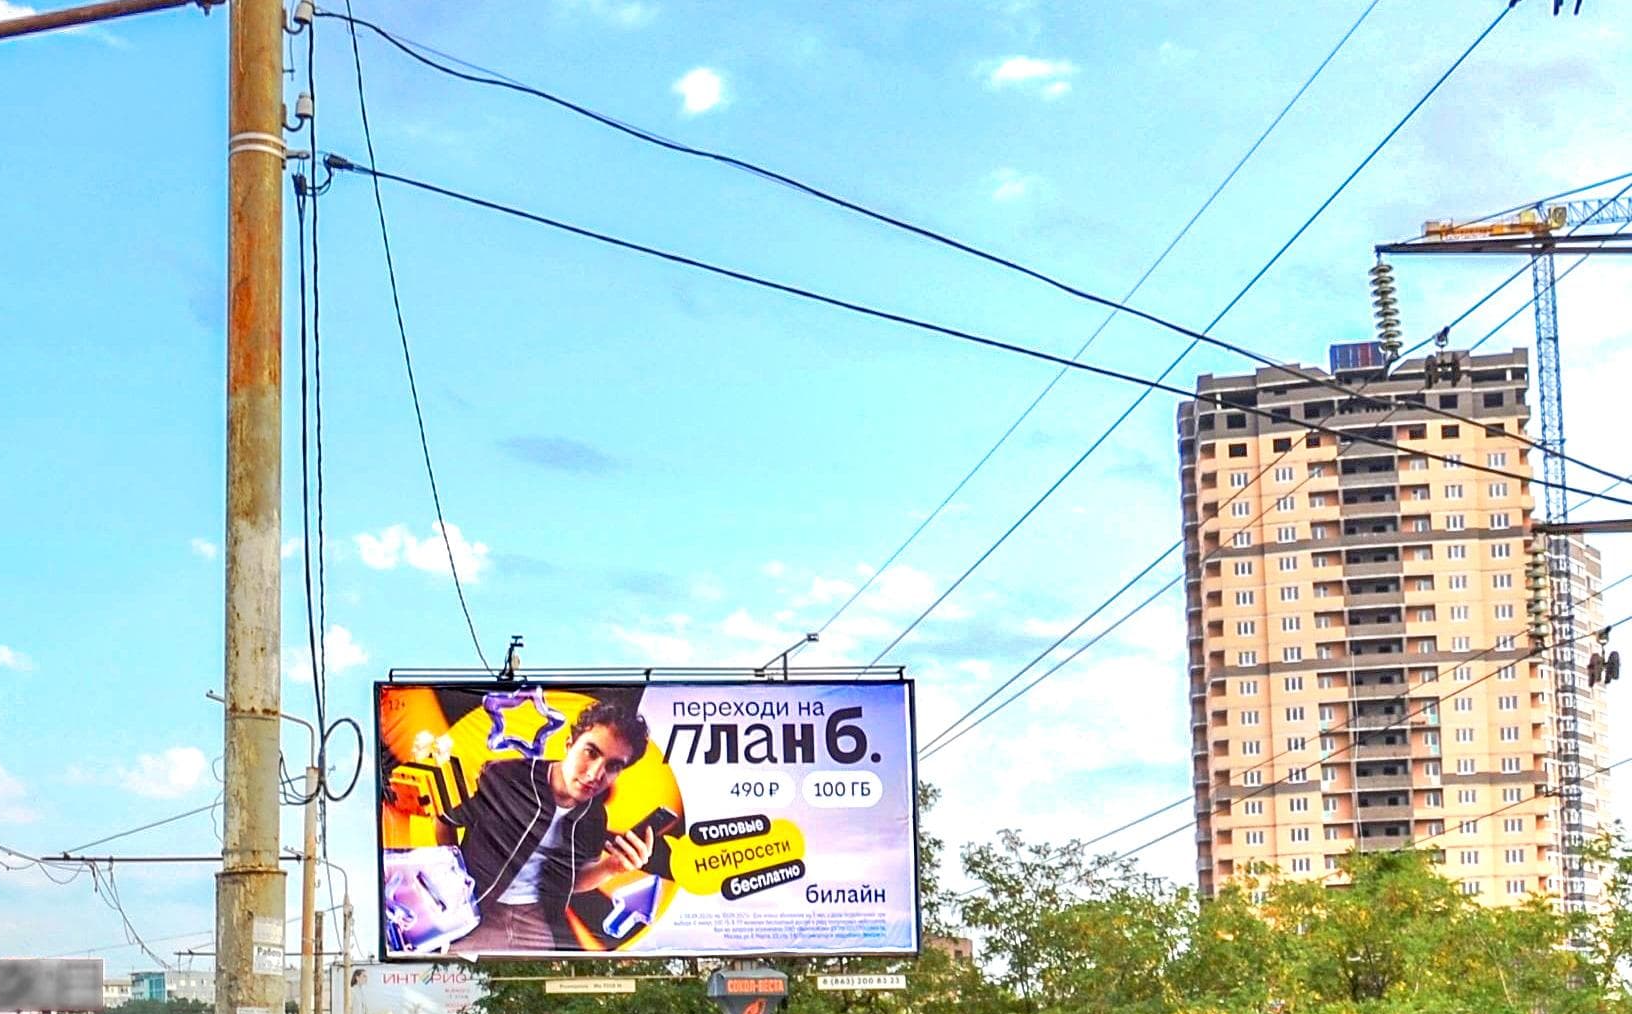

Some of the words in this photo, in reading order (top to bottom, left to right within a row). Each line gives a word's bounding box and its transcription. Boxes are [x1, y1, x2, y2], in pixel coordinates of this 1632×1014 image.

[672, 701, 789, 721] переходи
[798, 701, 825, 716] на
[730, 782, 765, 797] 490
[813, 782, 846, 797] 100
[851, 782, 871, 797] ГБ
[699, 818, 764, 840] топовые
[694, 839, 791, 873] нейросети
[730, 864, 800, 896] бесплатно
[806, 884, 886, 904] билайн
